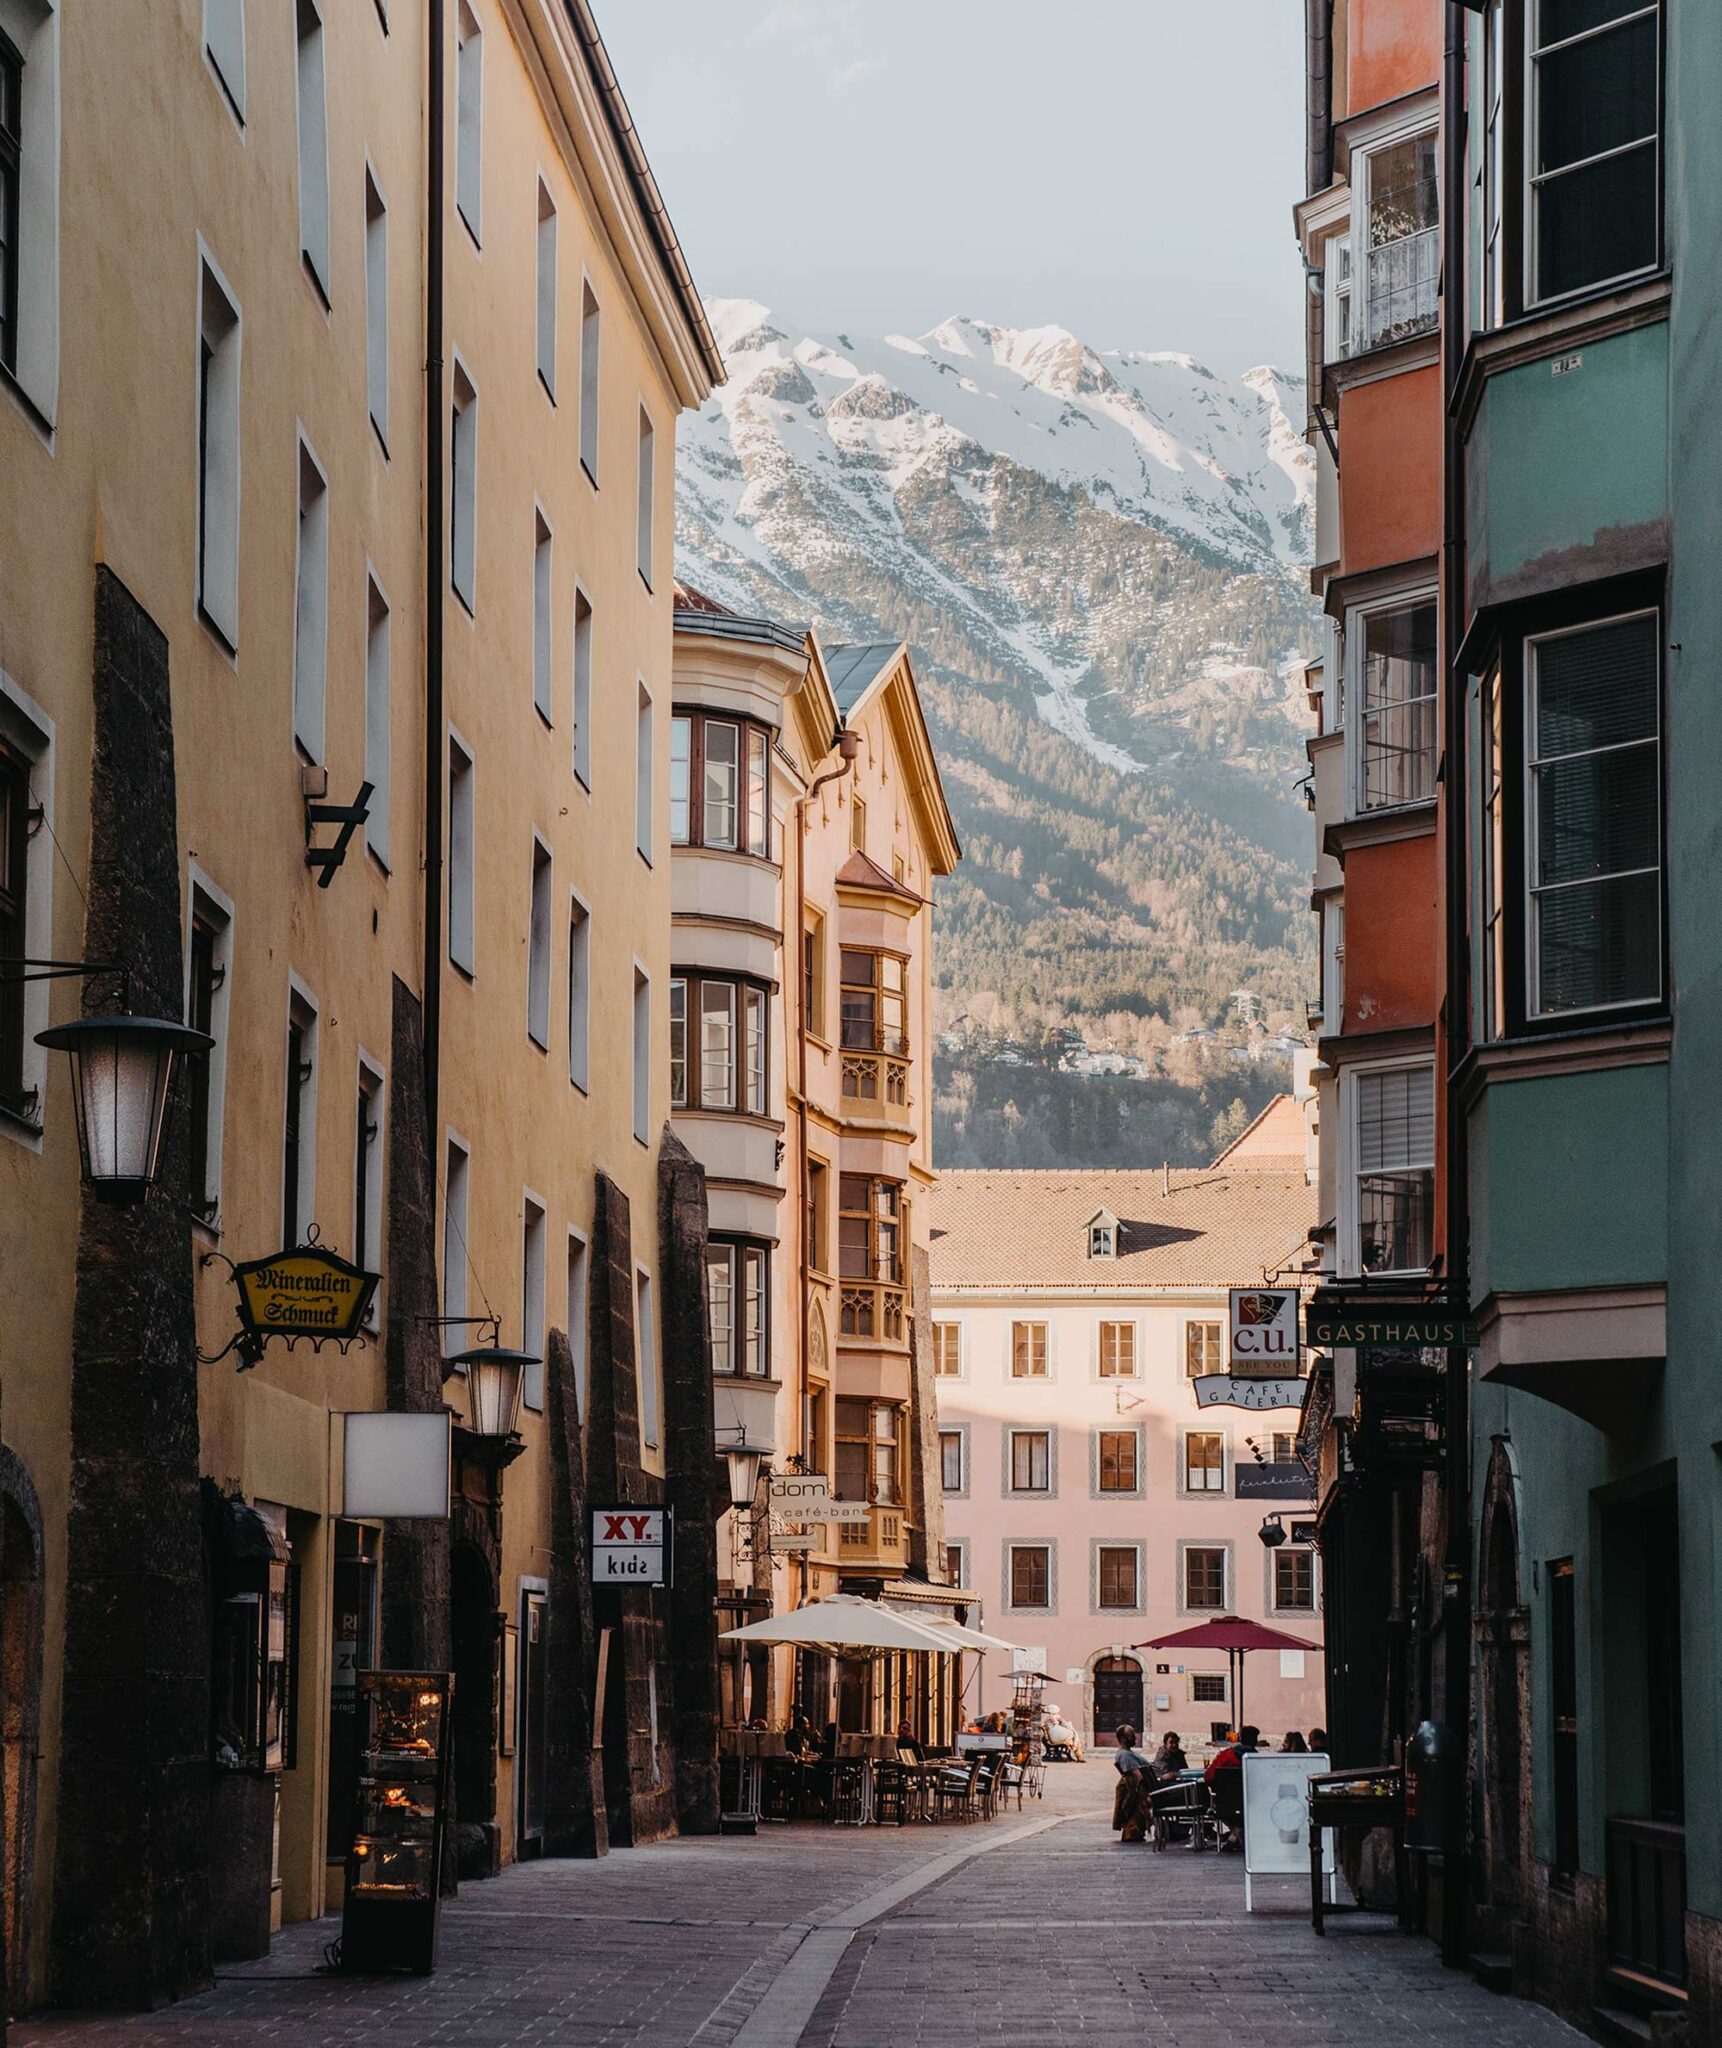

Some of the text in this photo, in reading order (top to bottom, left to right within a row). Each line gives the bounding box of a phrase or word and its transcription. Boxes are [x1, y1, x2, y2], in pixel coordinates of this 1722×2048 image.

[256, 1269, 351, 1294] Mineralien
[263, 1302, 339, 1324] Schmuck
[1316, 1324, 1454, 1342] GASTHAUS
[1238, 1360, 1290, 1369] SEE YOU
[771, 1480, 825, 1497] dom
[784, 1507, 860, 1517] café-bar
[608, 1554, 648, 1575] kids
